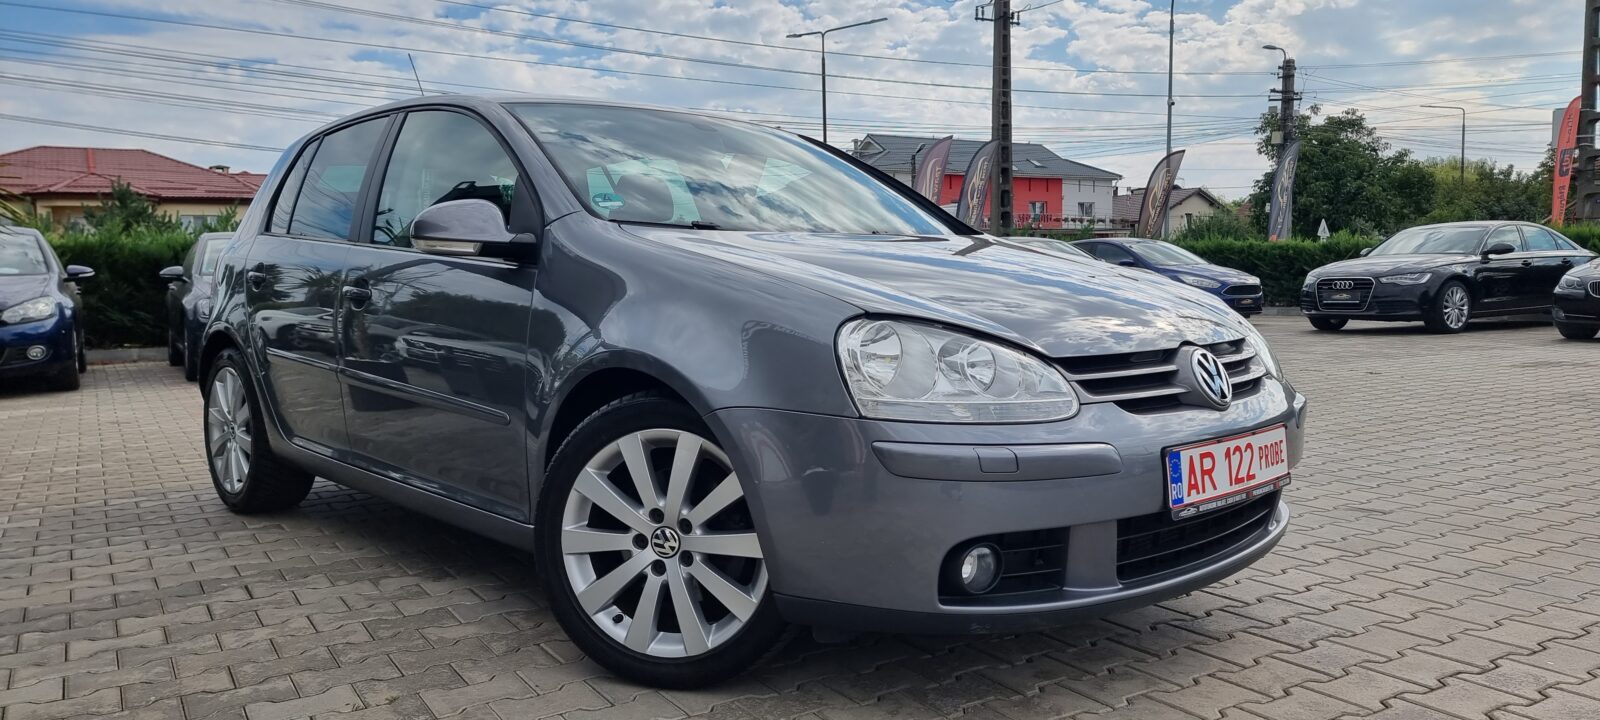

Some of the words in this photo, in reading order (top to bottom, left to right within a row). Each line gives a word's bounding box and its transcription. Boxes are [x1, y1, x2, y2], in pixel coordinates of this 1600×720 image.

[1187, 452, 1217, 497] AR
[1225, 443, 1256, 486] 122
[1258, 440, 1284, 470] PROBE
[1171, 482, 1183, 500] RO
